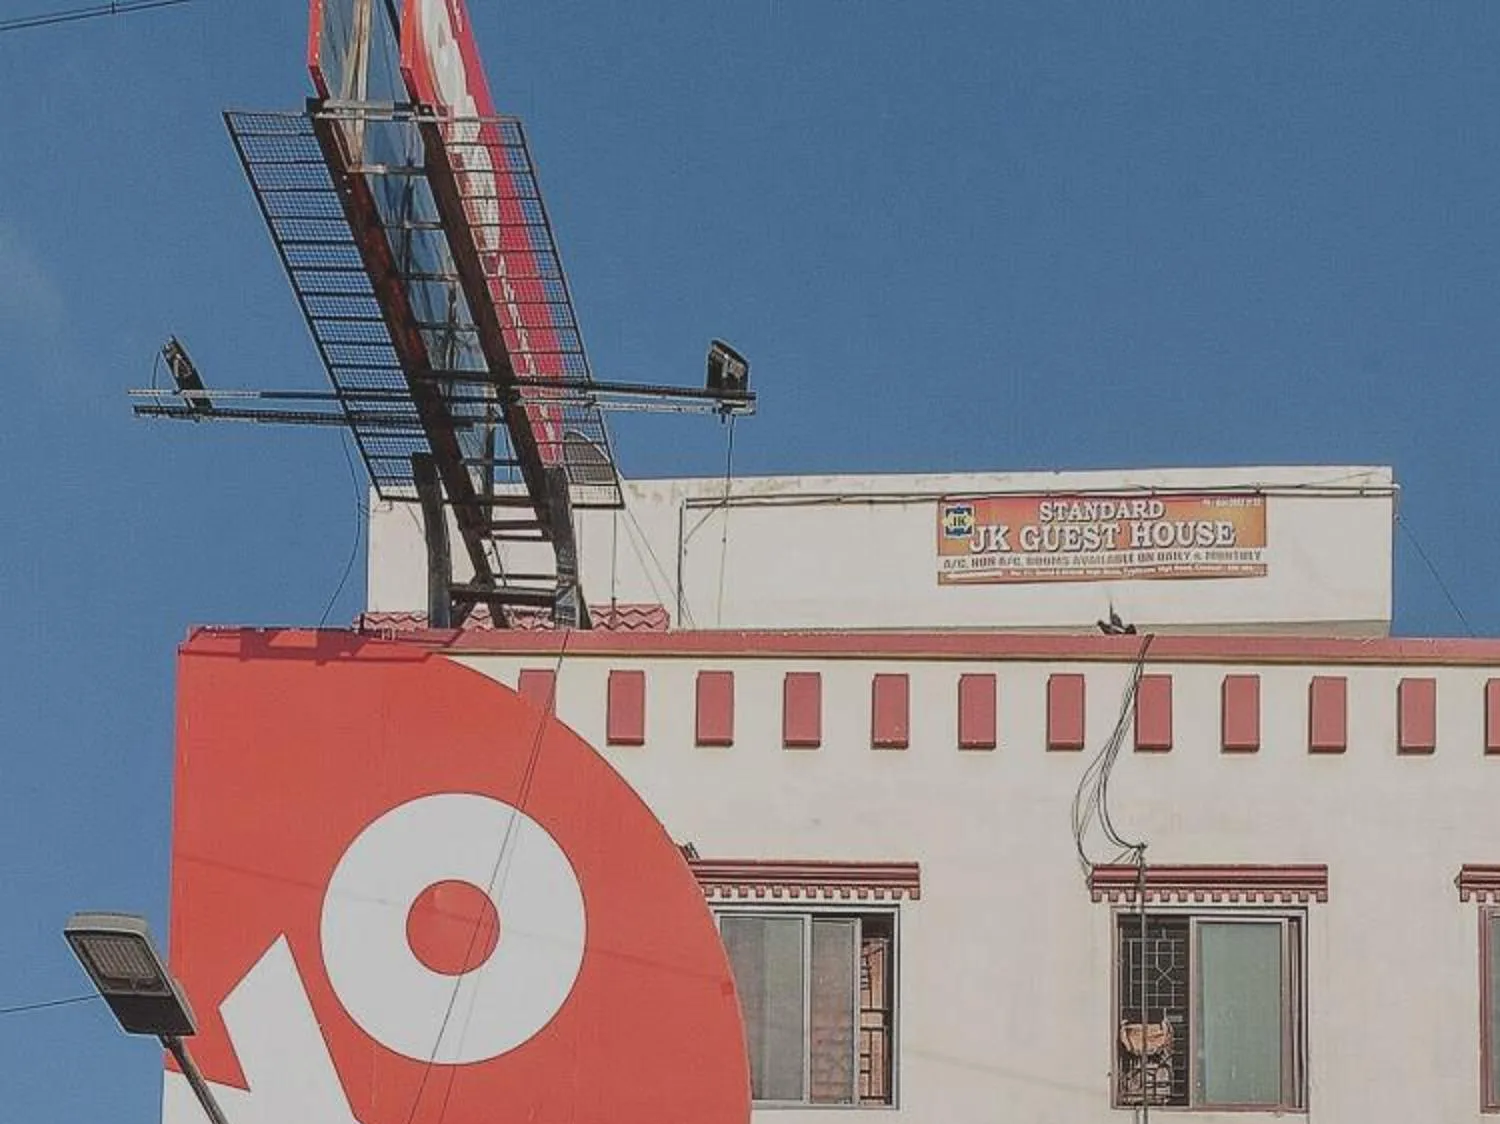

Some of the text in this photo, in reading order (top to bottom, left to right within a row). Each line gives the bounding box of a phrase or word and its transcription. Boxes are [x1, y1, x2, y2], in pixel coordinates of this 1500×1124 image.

[1039, 500, 1166, 523] STANDARD
[969, 520, 1237, 552] JK GUEST HOUSE
